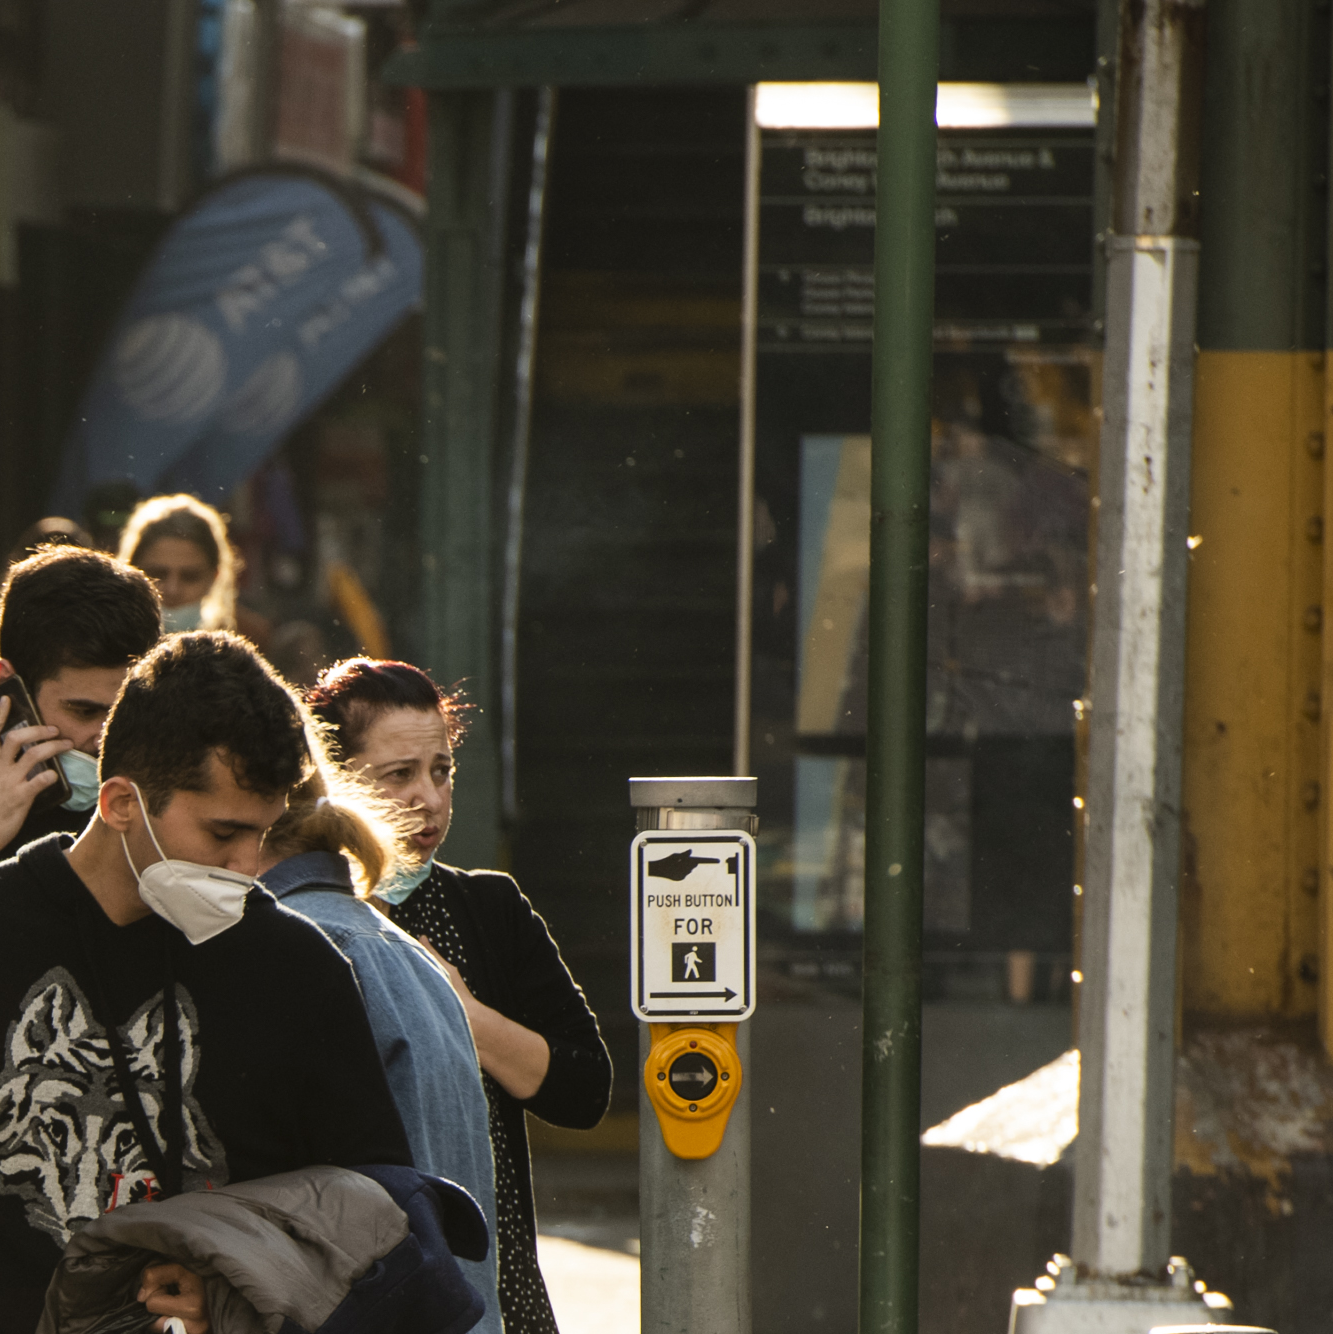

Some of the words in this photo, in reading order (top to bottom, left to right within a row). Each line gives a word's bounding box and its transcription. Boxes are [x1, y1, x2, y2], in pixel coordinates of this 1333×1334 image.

[647, 894, 681, 908] PUSH
[684, 893, 733, 908] BUTTON
[673, 918, 713, 935] FOR
